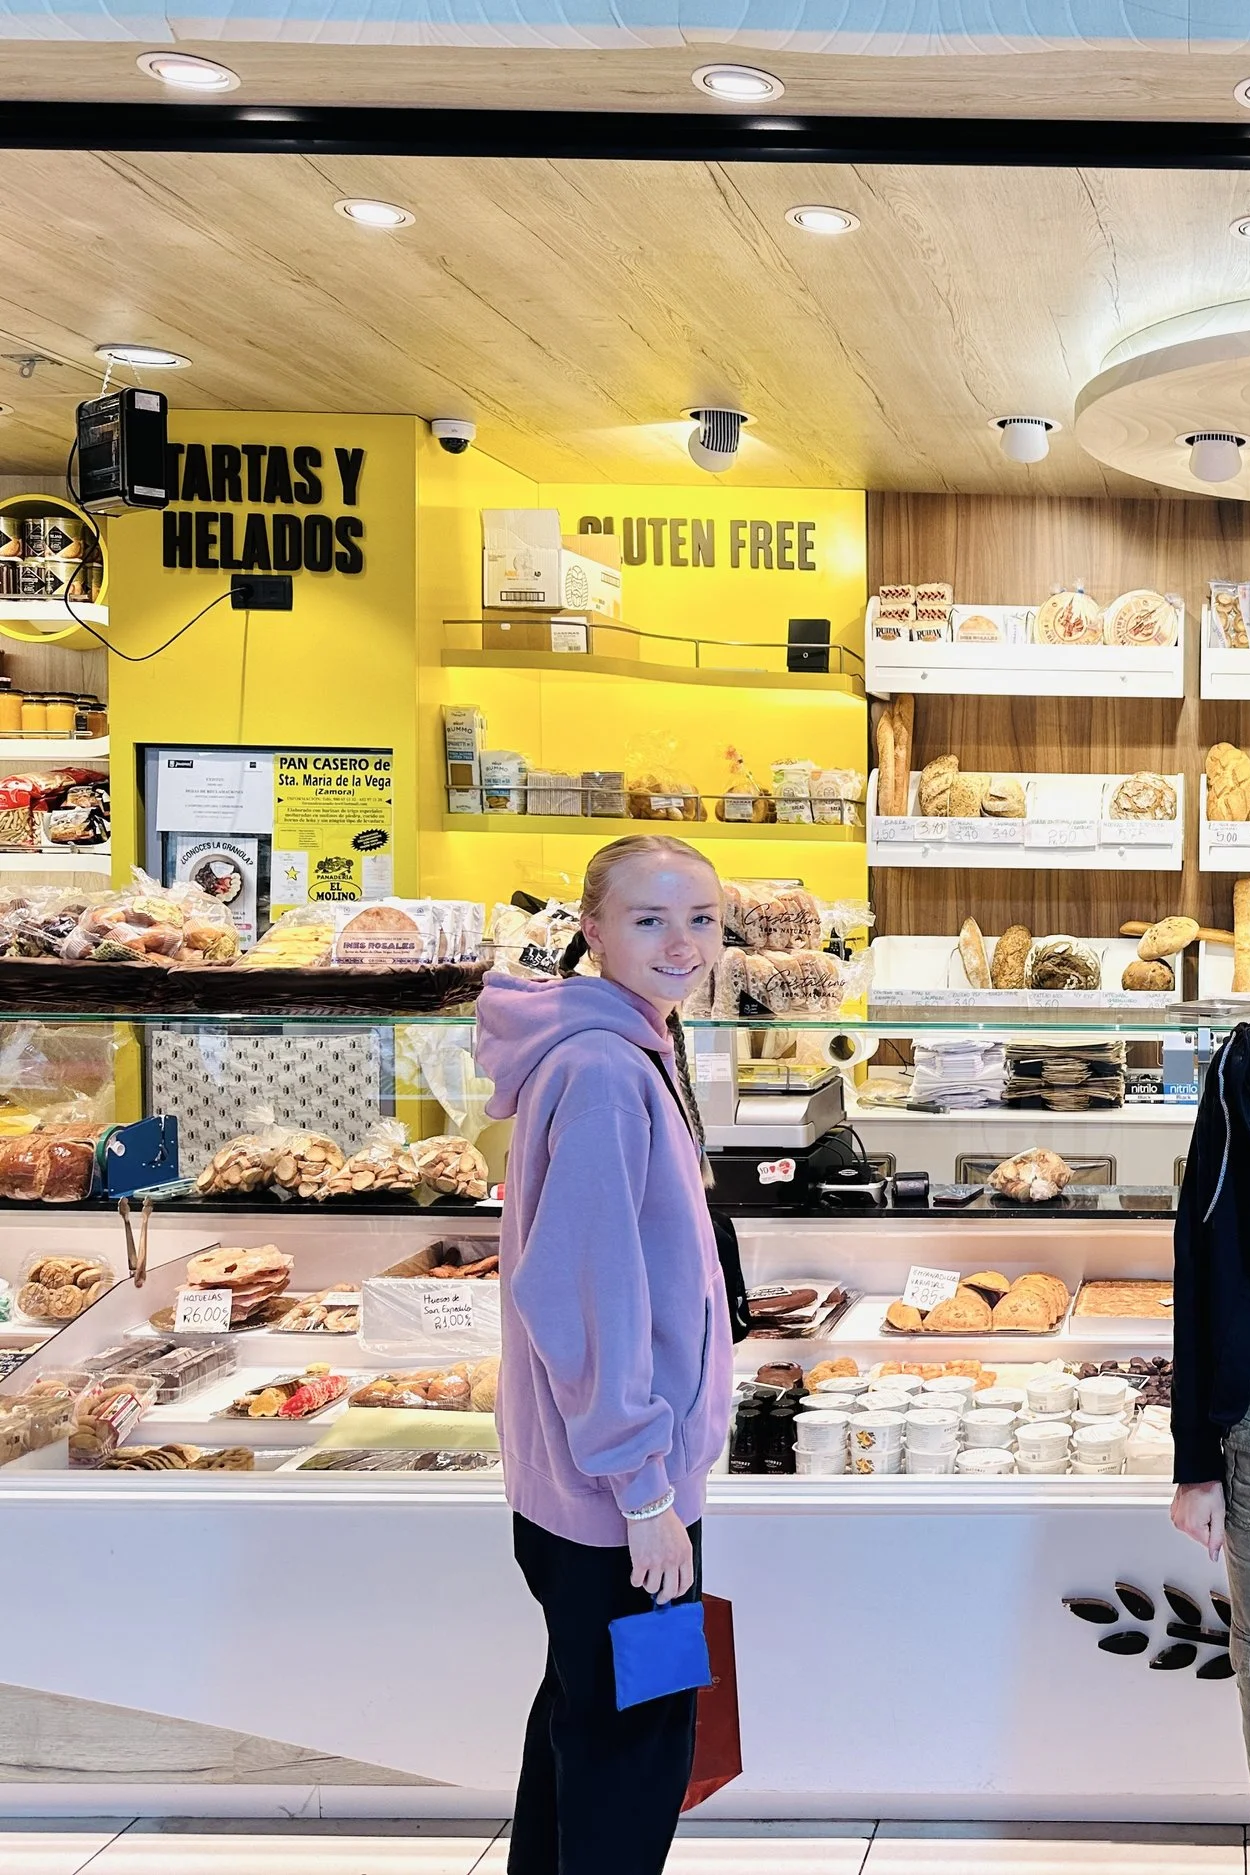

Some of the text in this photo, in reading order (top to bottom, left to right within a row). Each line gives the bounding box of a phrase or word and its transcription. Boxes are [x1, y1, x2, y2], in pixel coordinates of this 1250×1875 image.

[167, 443, 364, 505] TARTAS Y
[163, 511, 363, 574] HELADOS
[730, 520, 816, 571] FREE
[446, 726, 473, 735] RUMMO
[279, 757, 391, 771] PAN CASERO de
[279, 774, 298, 786] Sta.
[336, 775, 349, 787] de
[352, 775, 361, 787] la
[365, 775, 391, 791] Vega
[315, 788, 355, 796] (Zamora)
[212, 841, 221, 849] LA
[222, 842, 254, 866] GRANOLA?
[330, 882, 343, 891] EL
[316, 891, 356, 901] MOLINO
[781, 928, 812, 936] NATURAL
[343, 941, 415, 950] INES ROSALES
[1131, 1083, 1158, 1093] nitrilo
[1169, 1083, 1198, 1093] nitrilo
[423, 1294, 460, 1304] Huesos de
[424, 1306, 439, 1315] San
